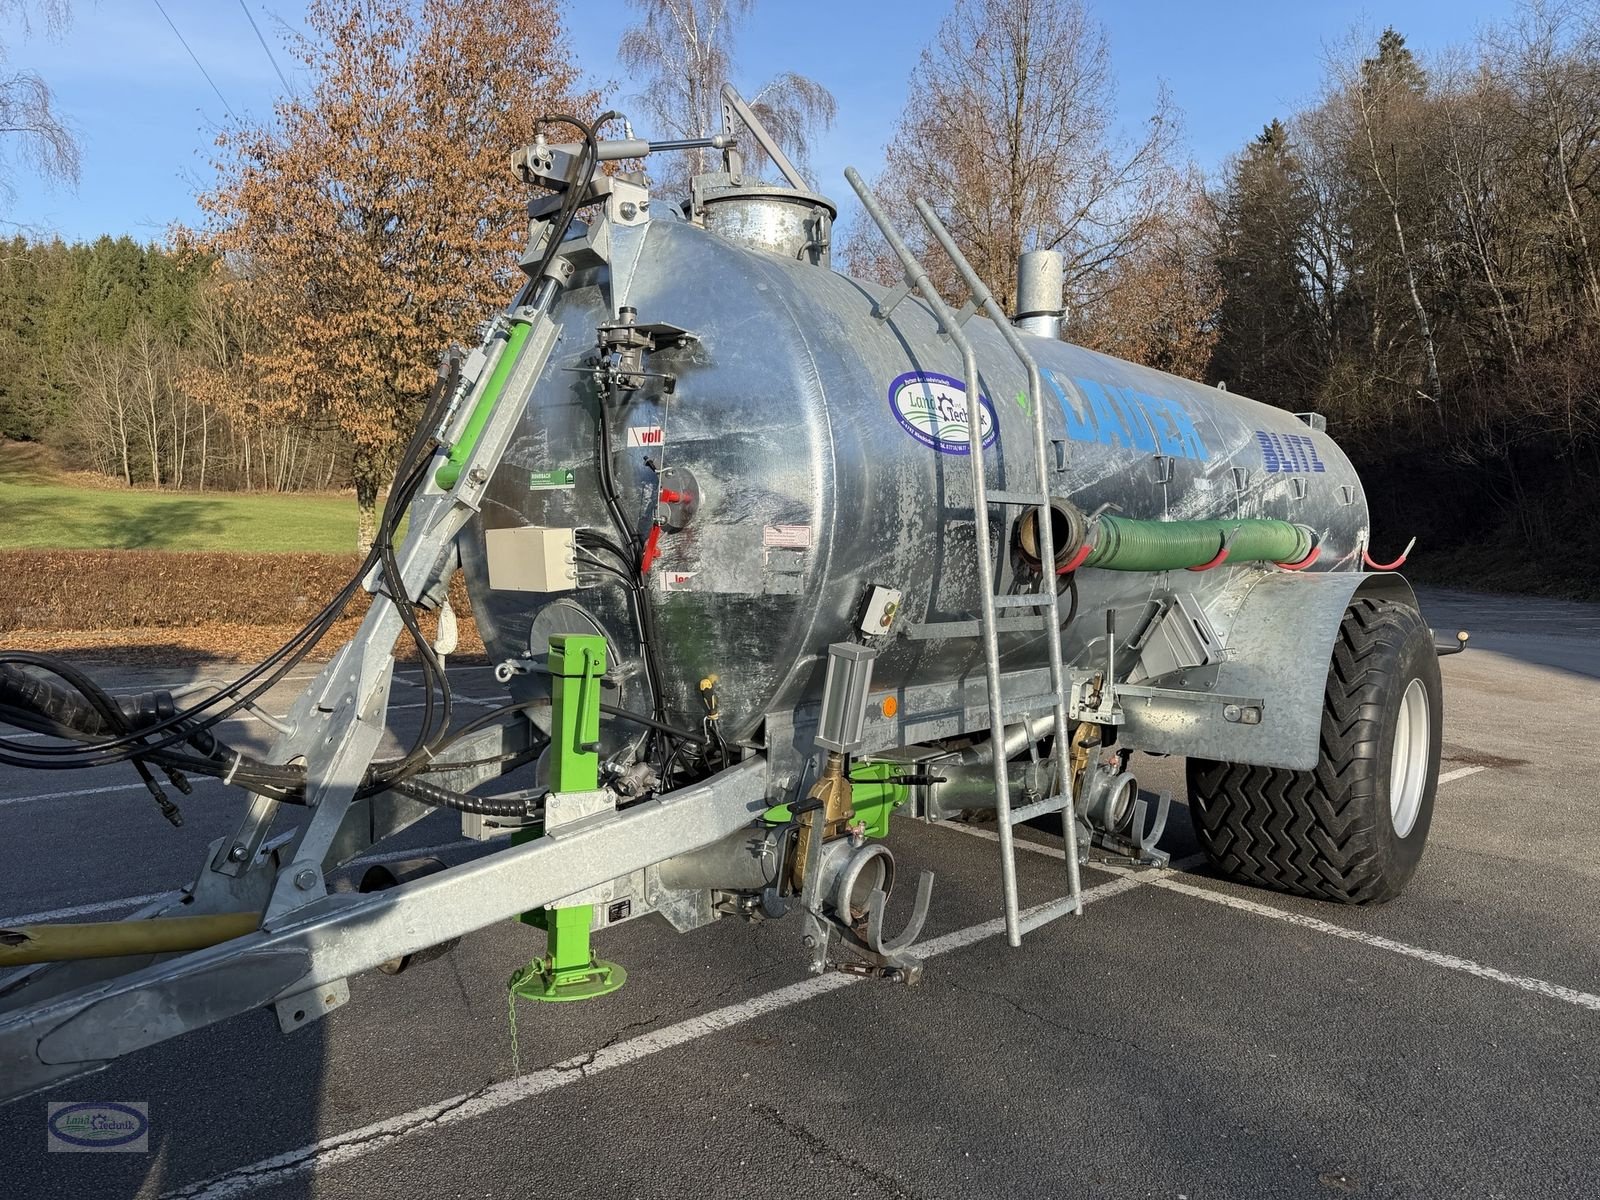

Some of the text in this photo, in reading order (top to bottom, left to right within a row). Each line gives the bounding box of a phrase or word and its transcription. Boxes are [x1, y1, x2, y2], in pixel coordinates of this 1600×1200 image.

[908, 391, 937, 411] Land
[946, 406, 988, 426] Techk
[642, 429, 661, 443] voll
[1255, 430, 1326, 473] BLITZ
